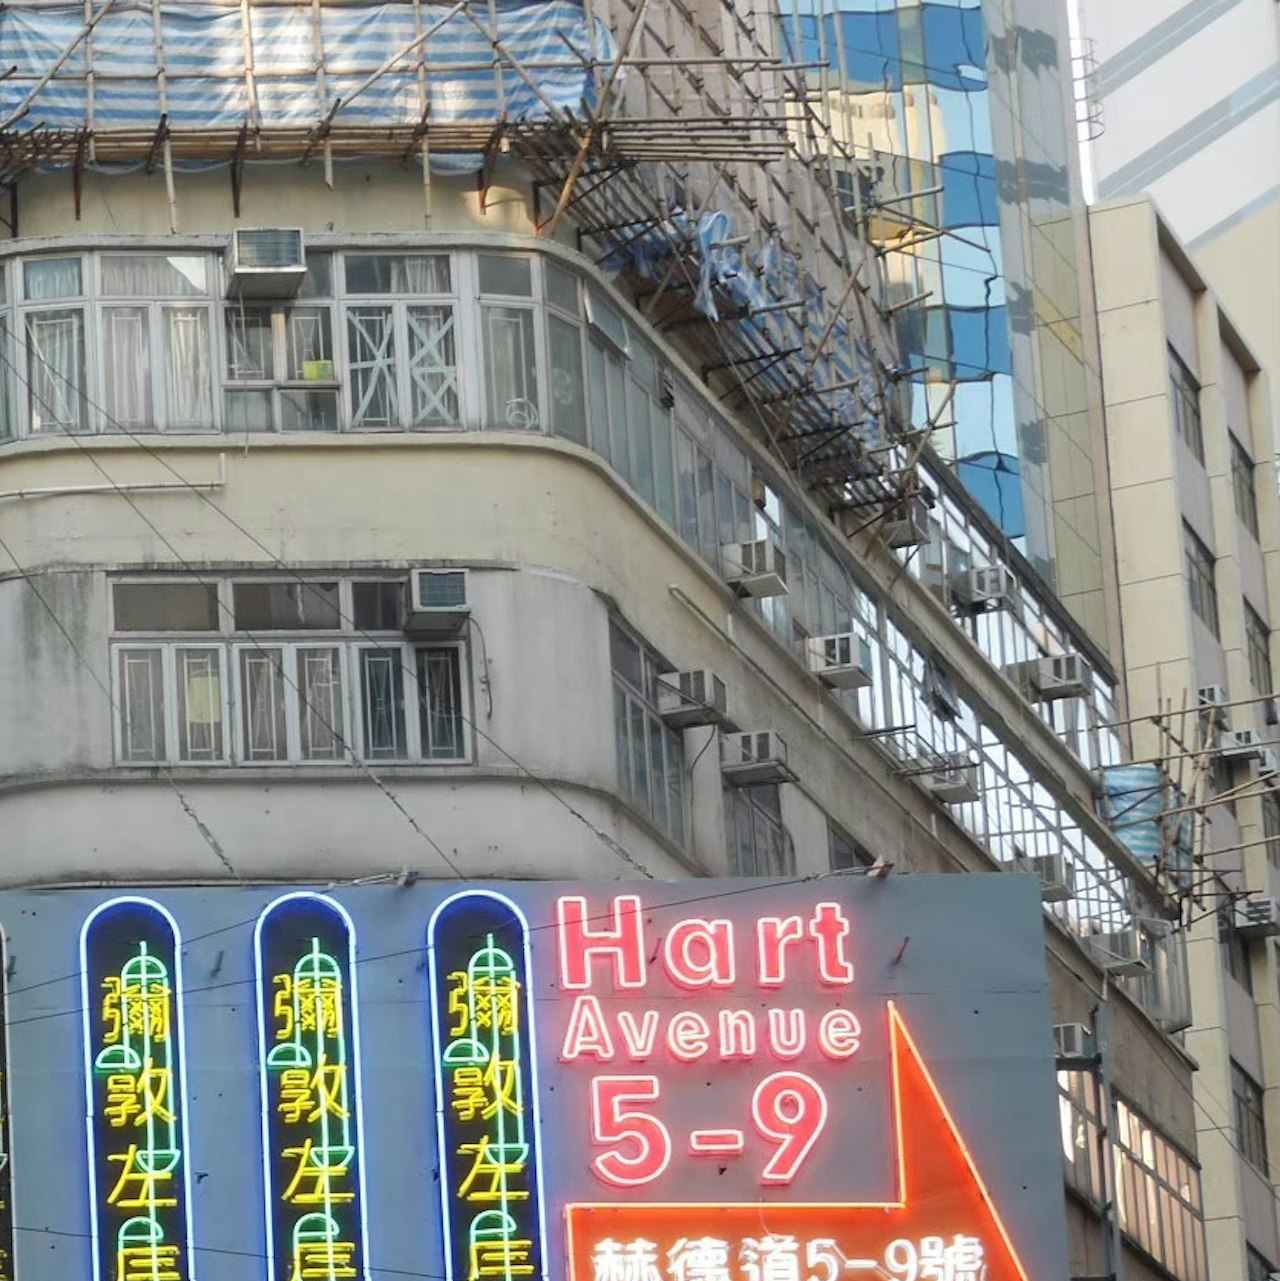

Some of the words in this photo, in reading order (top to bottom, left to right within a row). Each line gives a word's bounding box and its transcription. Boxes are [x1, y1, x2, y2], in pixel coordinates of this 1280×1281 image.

[557, 893, 856, 993] Hart
[562, 995, 864, 1062] Avenue
[590, 1070, 829, 1187] 5-9
